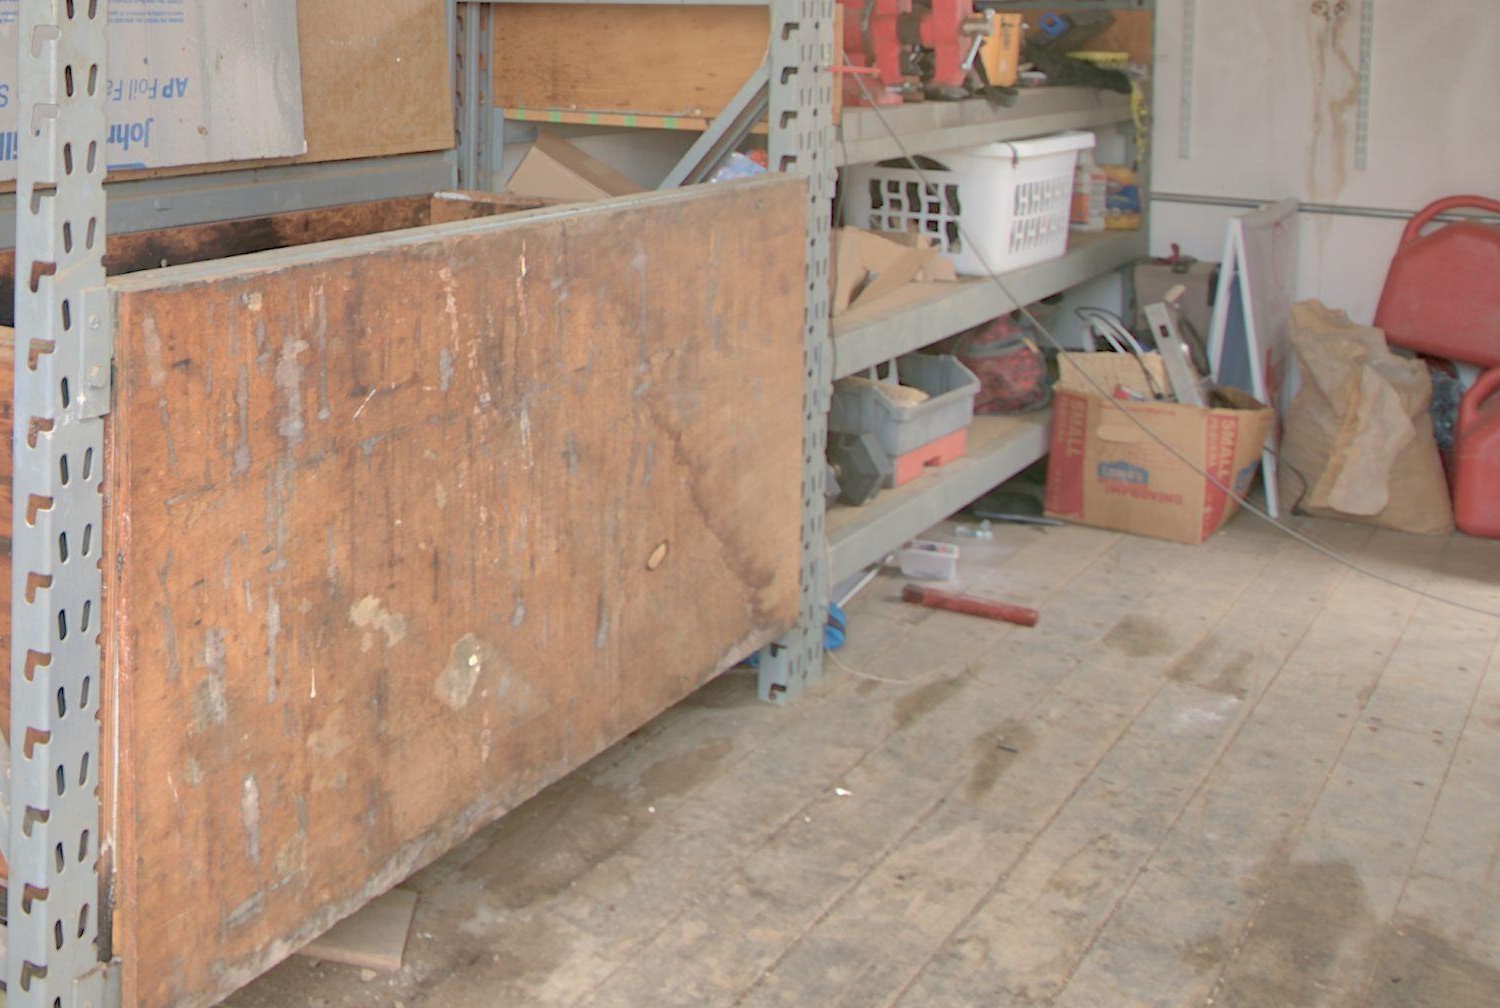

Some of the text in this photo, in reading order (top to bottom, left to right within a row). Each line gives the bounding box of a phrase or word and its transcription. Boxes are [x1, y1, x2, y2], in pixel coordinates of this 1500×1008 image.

[128, 78, 158, 102] Foil
[162, 76, 189, 99] AP
[1220, 418, 1237, 478] SMALL
